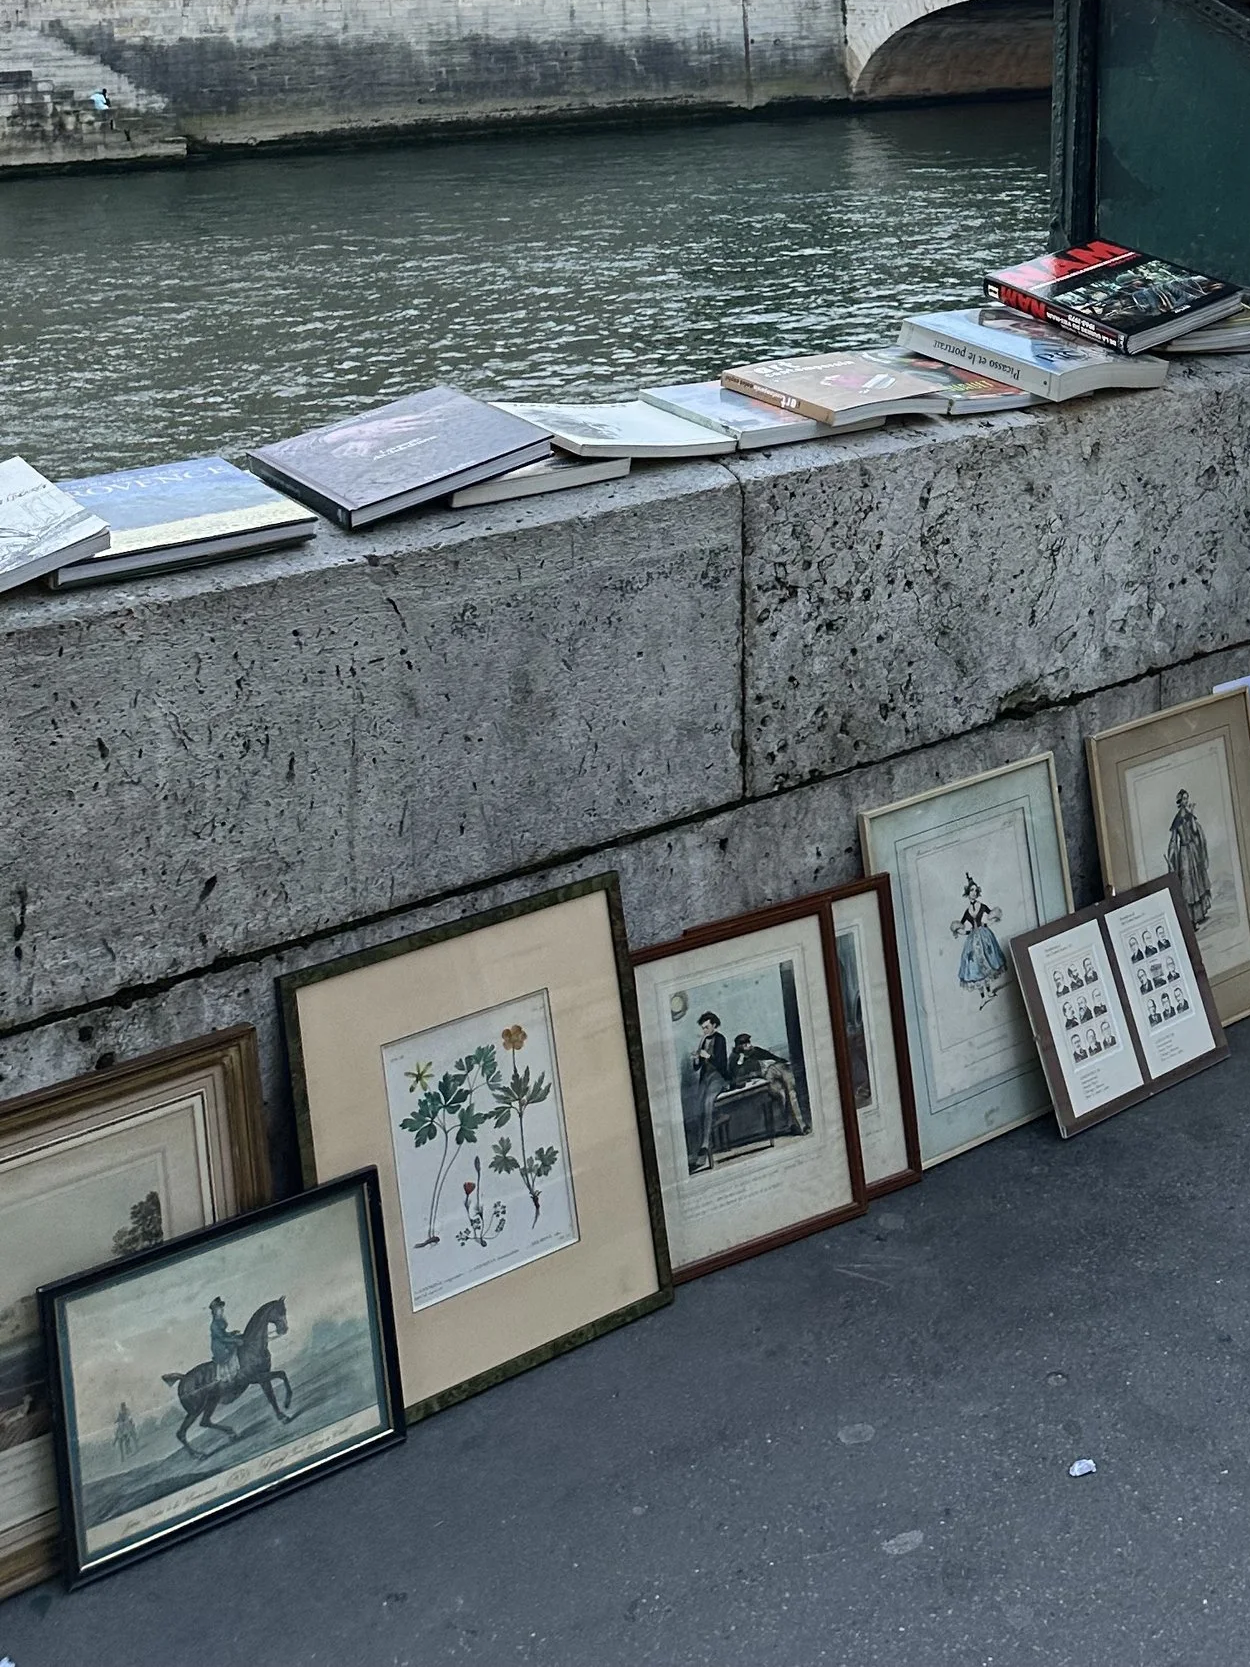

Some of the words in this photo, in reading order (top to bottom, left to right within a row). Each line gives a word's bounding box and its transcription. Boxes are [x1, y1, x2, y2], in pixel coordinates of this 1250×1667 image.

[1000, 240, 1129, 284] NAM
[1000, 286, 1047, 320] NAM
[933, 339, 967, 358] portrait
[968, 350, 976, 365] le
[975, 353, 988, 366] et
[989, 358, 1021, 381] Picasso
[66, 464, 228, 499] ROVENCE
